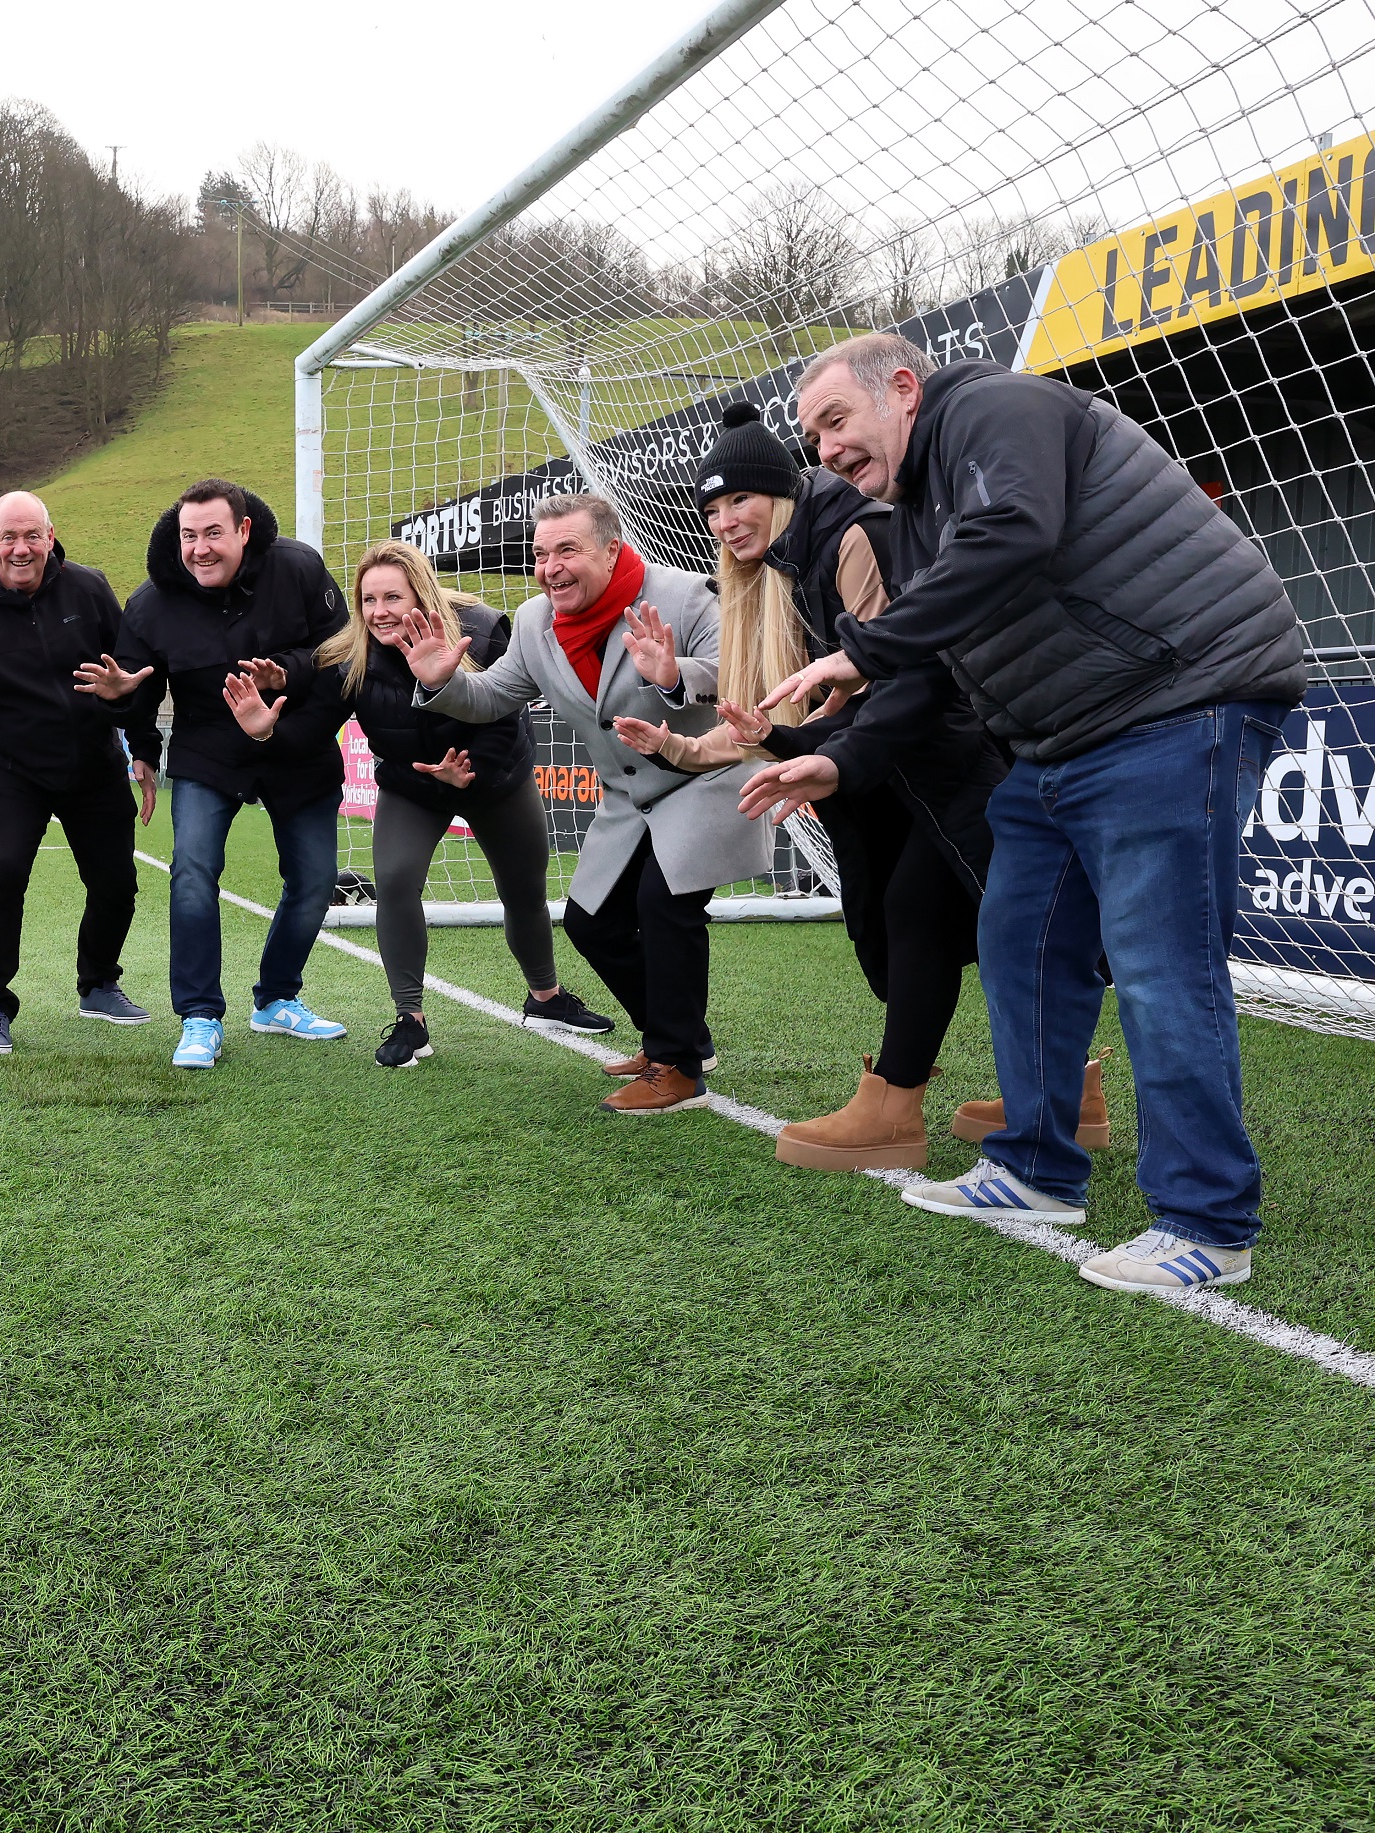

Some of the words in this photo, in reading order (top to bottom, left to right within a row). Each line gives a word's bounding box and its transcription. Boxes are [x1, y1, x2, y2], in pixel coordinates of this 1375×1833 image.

[1101, 146, 1375, 341] LEADIN
[400, 497, 482, 557] FORTUS
[492, 474, 573, 526] BUSINESS
